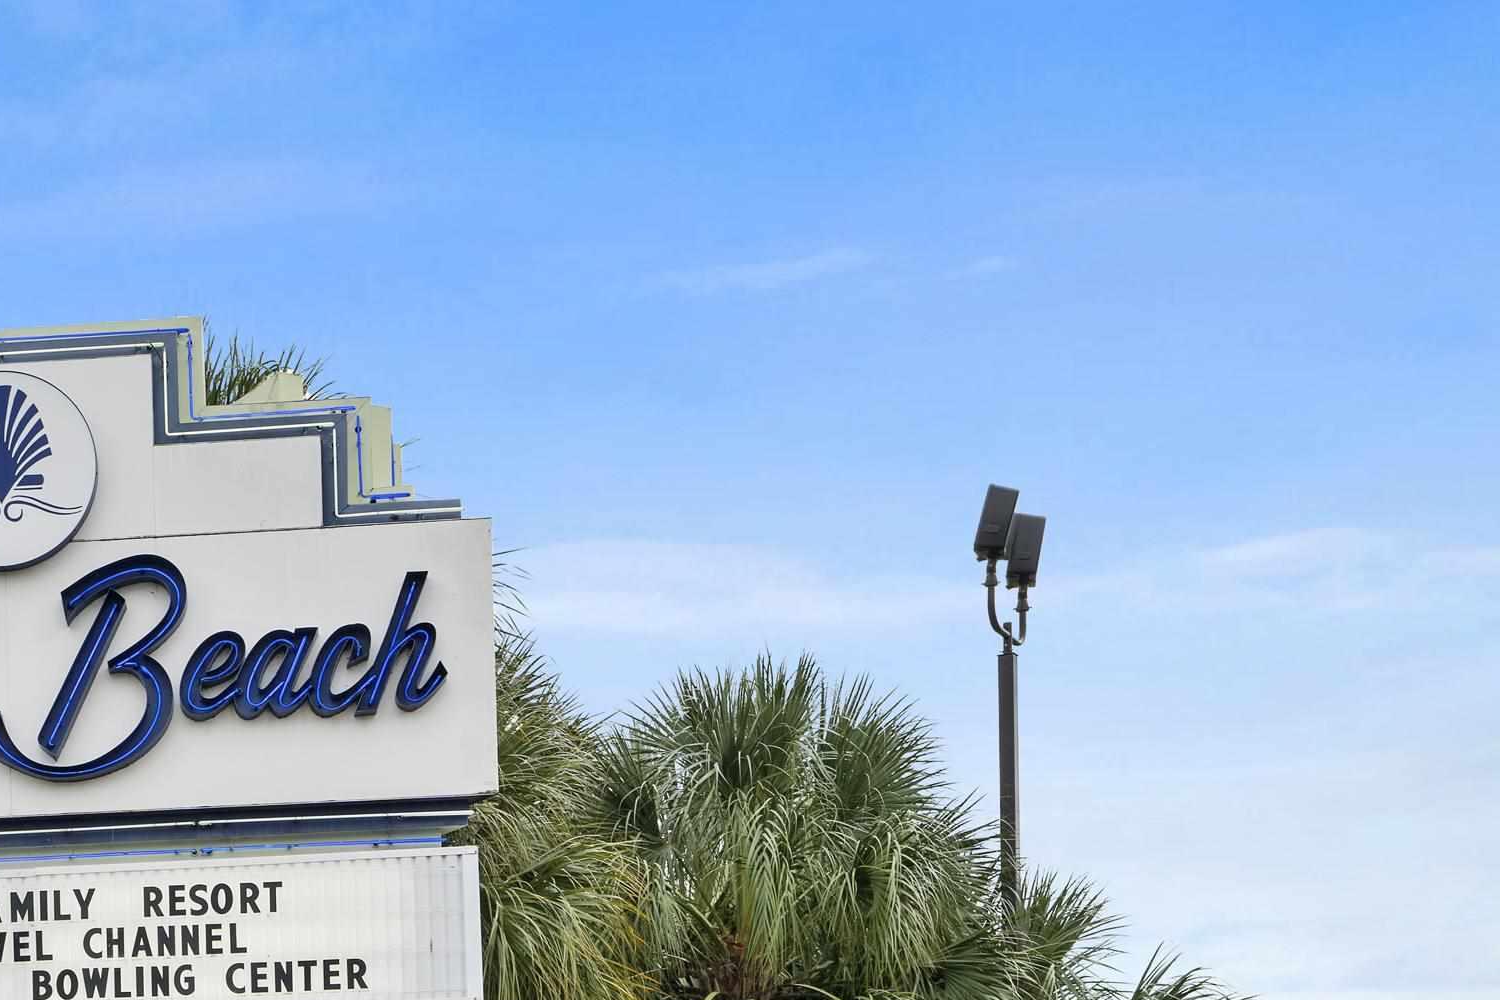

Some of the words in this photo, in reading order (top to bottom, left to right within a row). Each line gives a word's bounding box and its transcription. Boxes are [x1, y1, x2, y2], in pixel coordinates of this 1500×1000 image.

[143, 881, 283, 918] RESORT
[83, 922, 248, 959] CHANNEL
[32, 963, 196, 1000] BOWLING
[225, 957, 368, 994] CENTER
